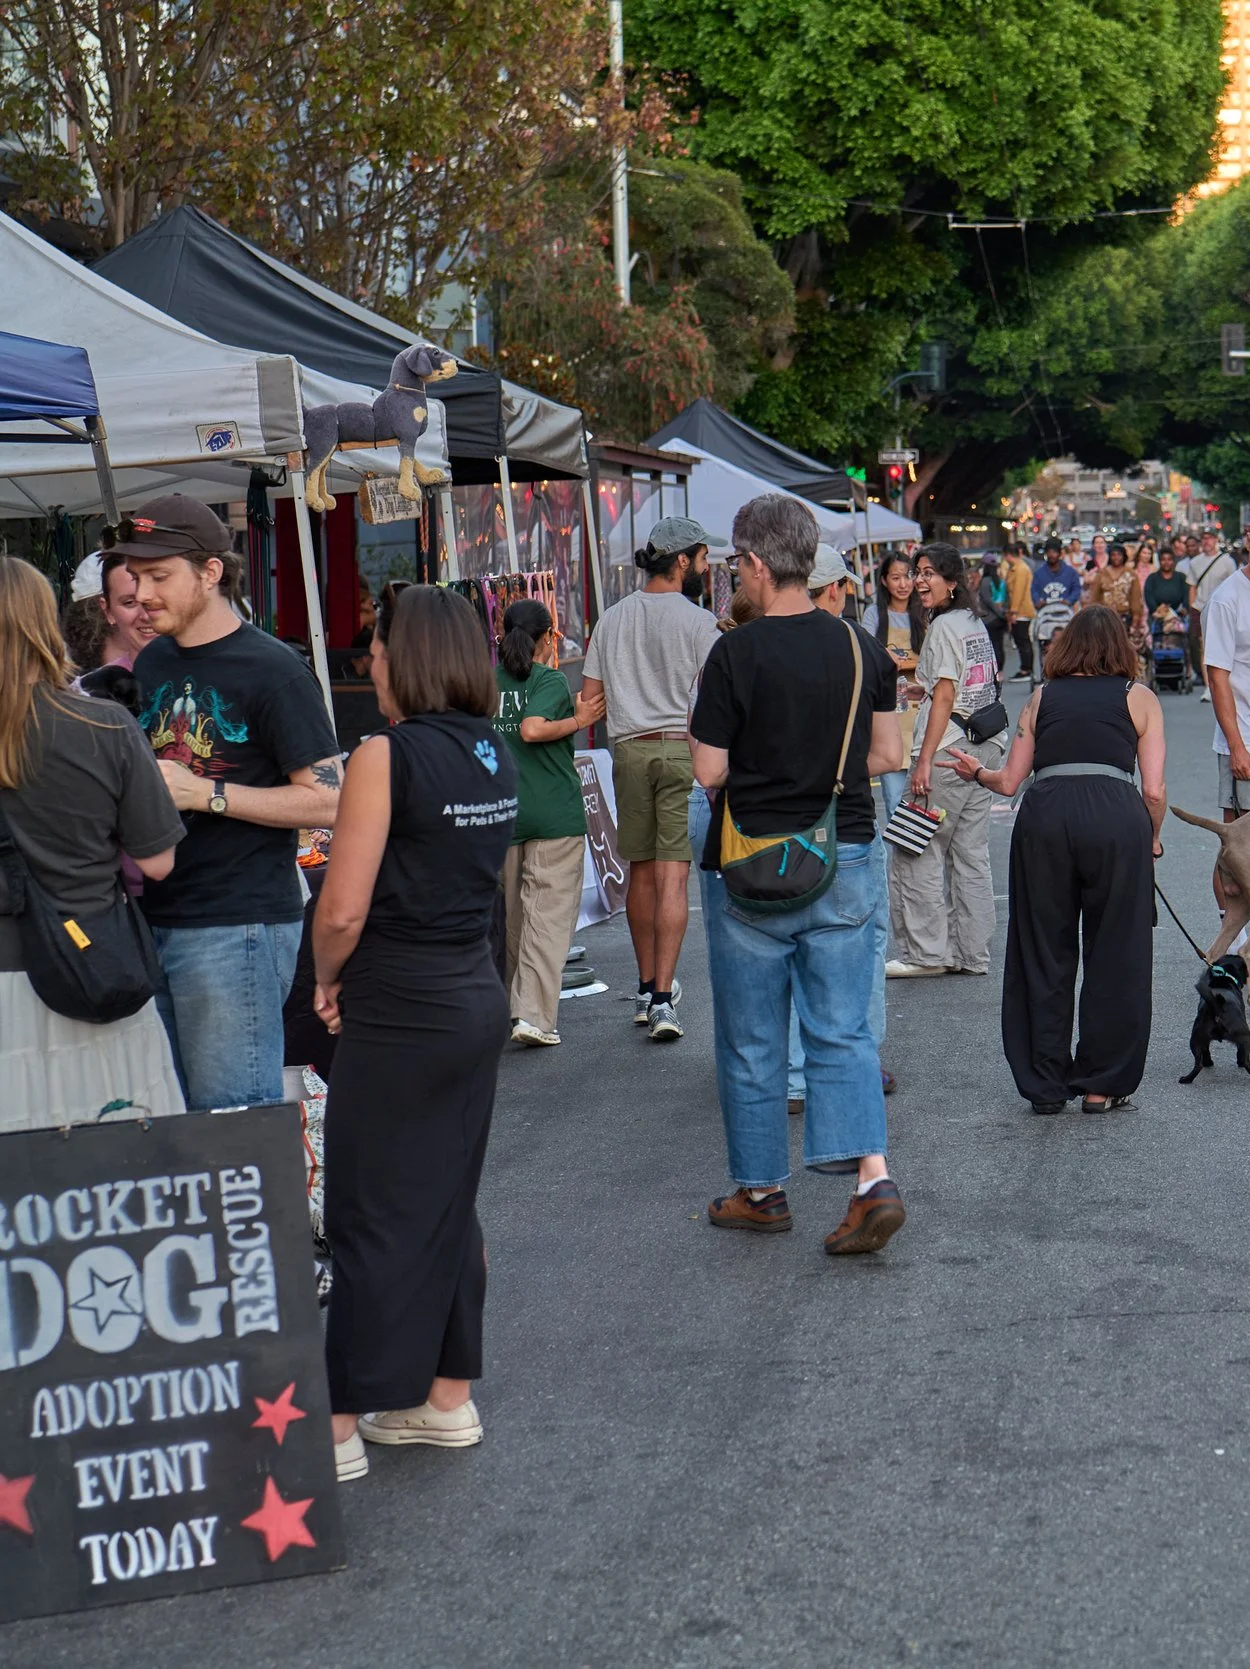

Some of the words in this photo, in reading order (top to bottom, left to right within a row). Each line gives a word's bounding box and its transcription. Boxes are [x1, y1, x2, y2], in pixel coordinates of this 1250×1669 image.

[442, 804, 453, 815] A
[453, 803, 498, 816] Marketplace
[455, 816, 469, 827] for
[469, 815, 488, 826] Pets
[219, 1165, 280, 1339] RESCUE
[0, 1233, 229, 1371] DOG
[30, 1361, 241, 1438] ADOPTION
[74, 1441, 210, 1508] EVENT
[79, 1516, 219, 1585] TODAY
